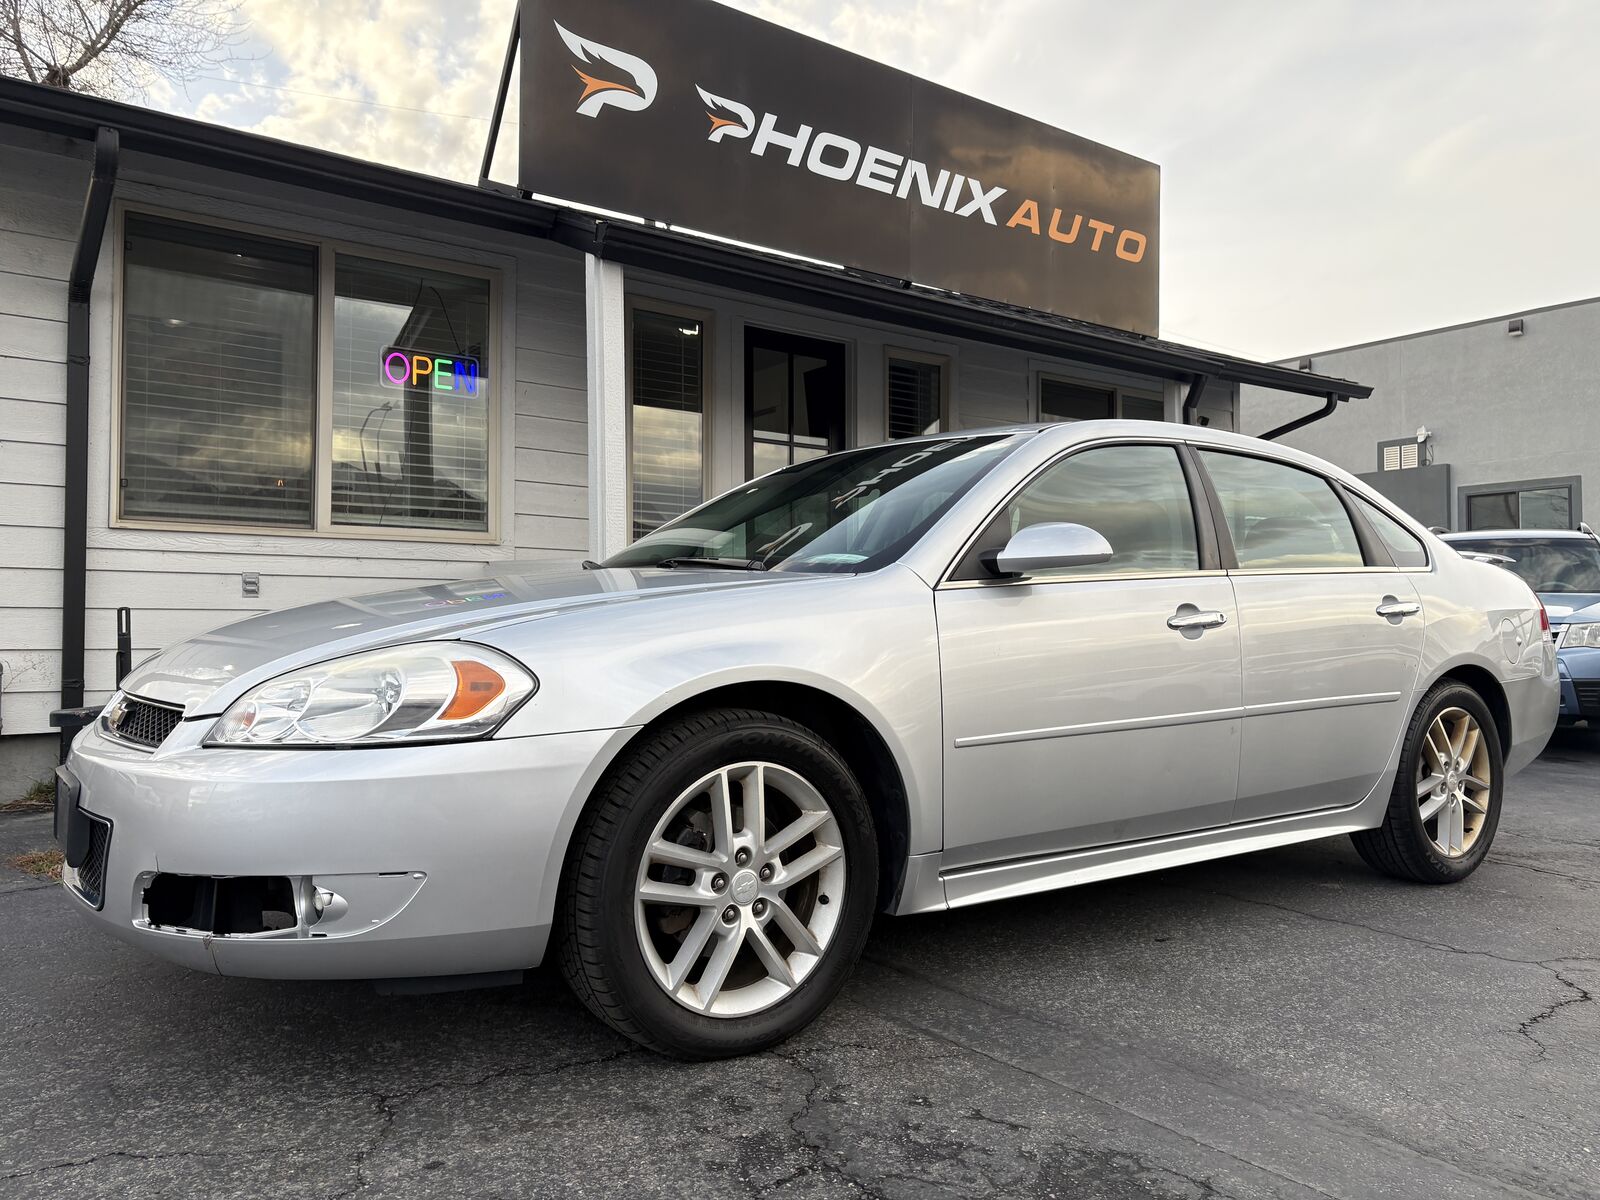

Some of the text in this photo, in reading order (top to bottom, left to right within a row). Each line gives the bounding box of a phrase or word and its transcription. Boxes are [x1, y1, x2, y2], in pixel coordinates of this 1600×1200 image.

[695, 83, 1147, 263] PHOENIX AUTO
[385, 352, 475, 394] OPEN
